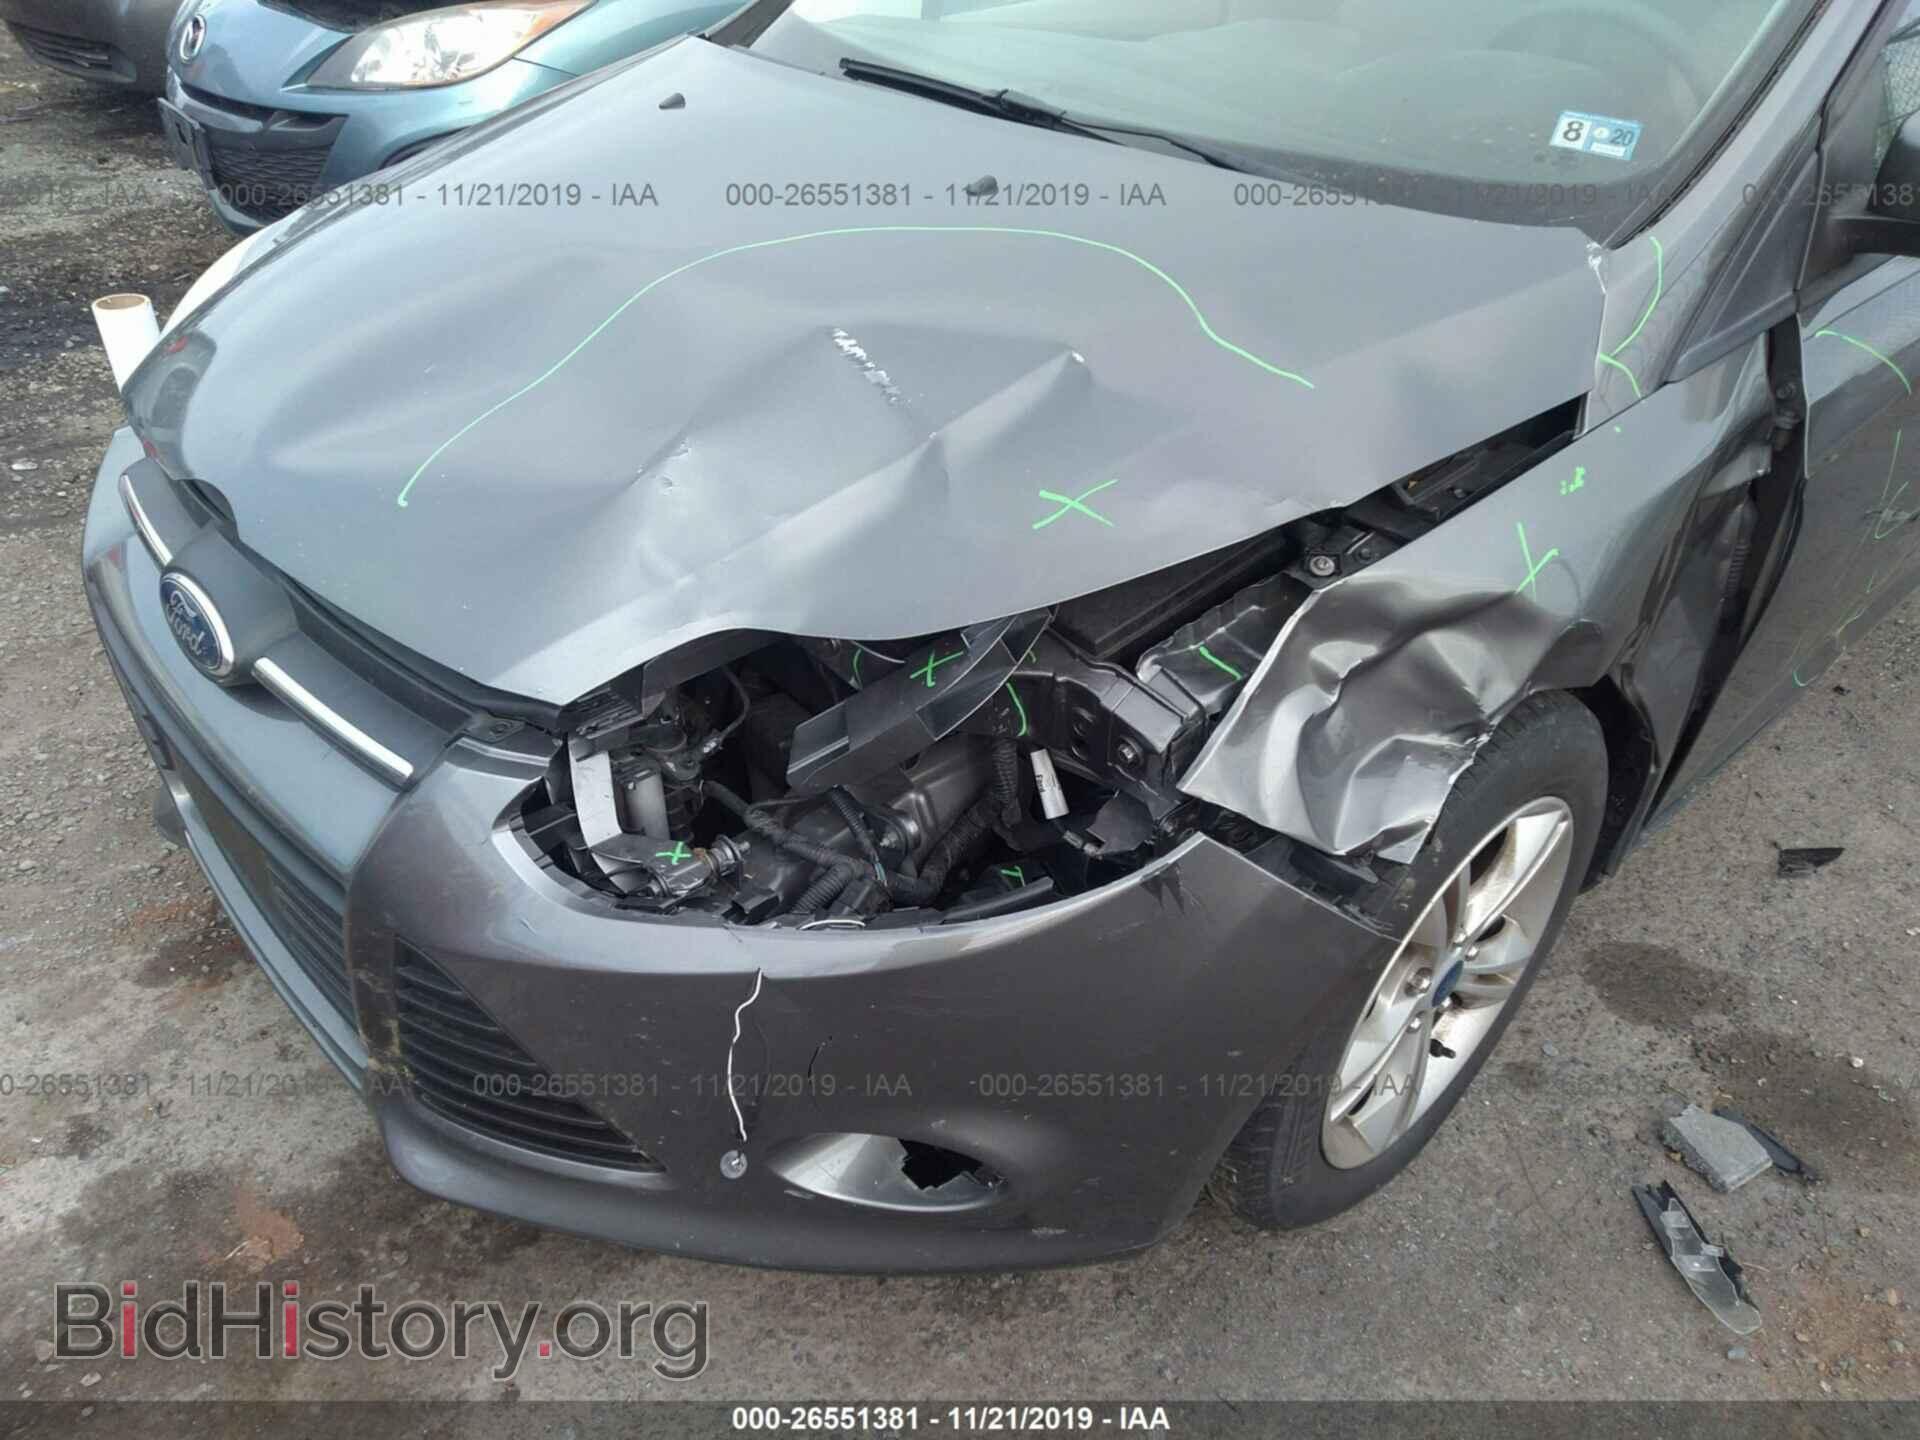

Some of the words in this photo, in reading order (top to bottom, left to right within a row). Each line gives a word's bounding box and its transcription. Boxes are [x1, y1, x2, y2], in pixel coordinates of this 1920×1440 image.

[1562, 120, 1585, 142] 8
[1611, 127, 1634, 146] 20
[166, 590, 205, 655] Ford
